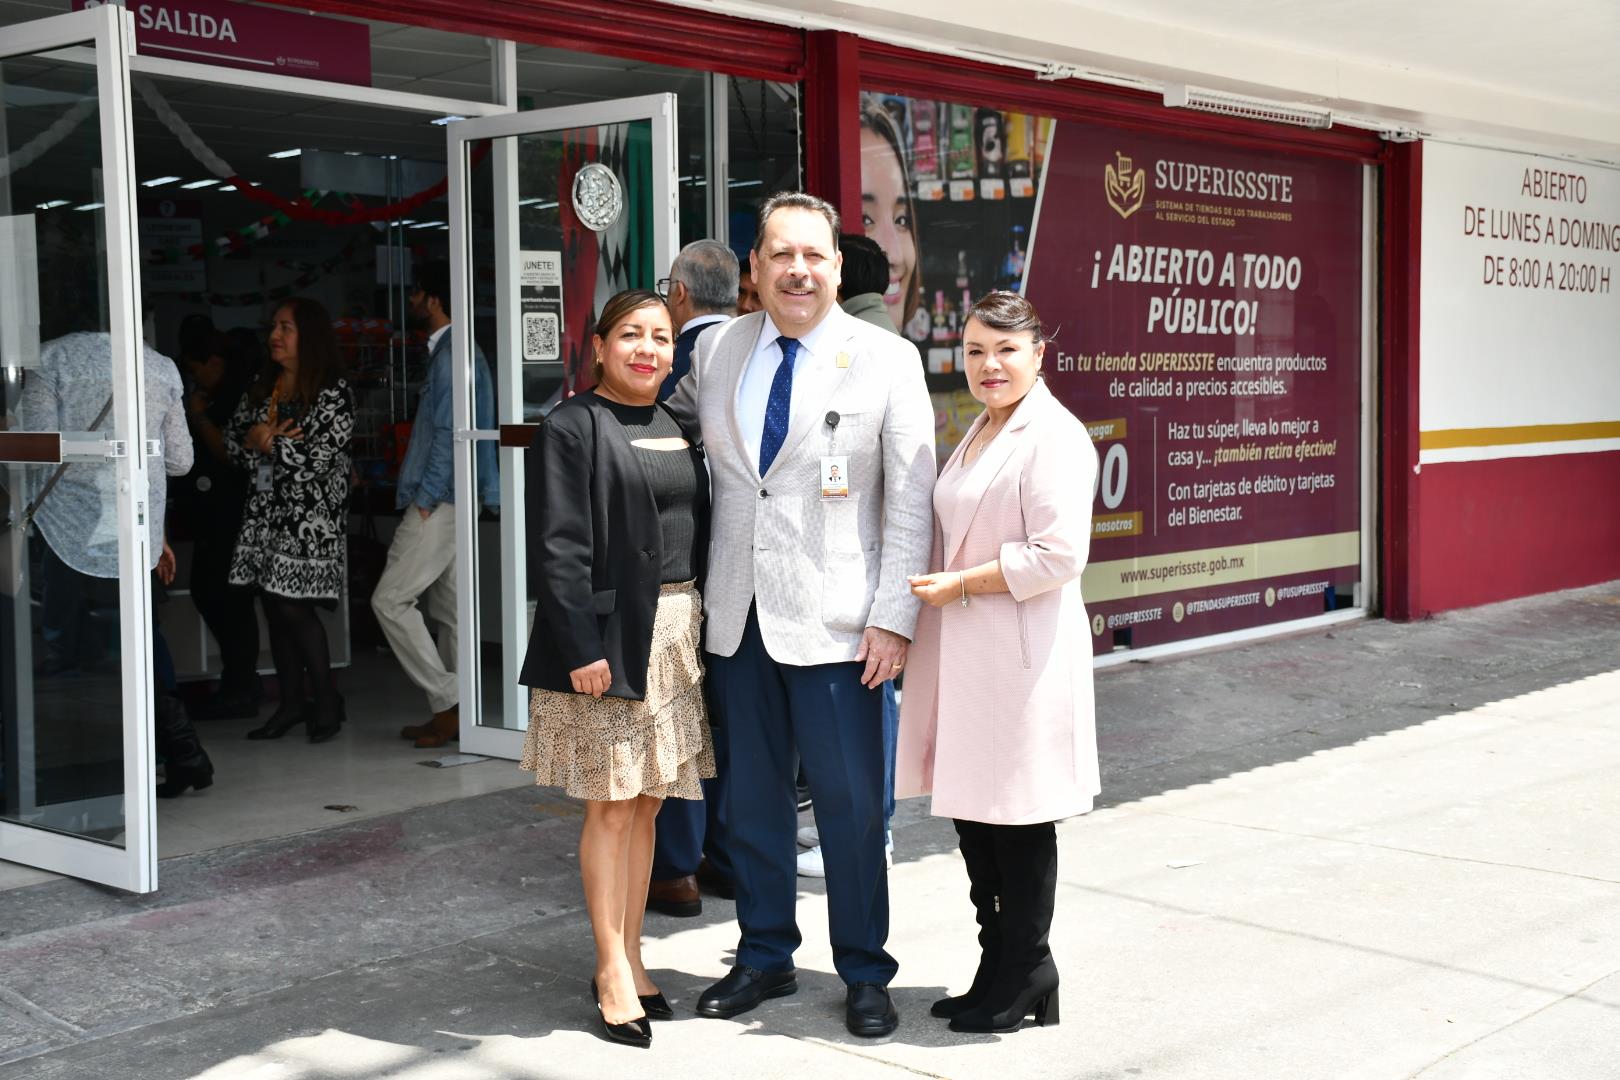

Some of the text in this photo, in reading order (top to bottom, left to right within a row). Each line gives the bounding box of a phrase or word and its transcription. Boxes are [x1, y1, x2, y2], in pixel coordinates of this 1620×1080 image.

[139, 4, 237, 43] SALIDA
[1155, 159, 1293, 203] SUPERISSSTE
[1521, 168, 1587, 204] ABIERTO
[1155, 200, 1293, 221] SISTEMA DE TIENDAS DE LOS TRABAJADORES
[1155, 212, 1236, 227] AL SERVICIO DEL ESTADO
[1464, 205, 1486, 238] DE
[1490, 208, 1541, 244] LUNES
[1544, 215, 1556, 245] A
[1218, 252, 1236, 287] A
[1243, 253, 1302, 291] TODO
[1483, 255, 1611, 294] DE 8:00 A 20:00 H
[1147, 287, 1259, 335] PÚBLICO!
[1057, 352, 1327, 376] En tu tienda SUPERISSSTE encuentra productos
[1109, 376, 1288, 401] de calidad a precios accesibles.
[1167, 417, 1320, 442] Haz tu súper, lleva lo mejor a
[1167, 450, 1194, 467] casa
[1213, 441, 1263, 468] ¡también
[1264, 441, 1293, 460] retira
[1294, 439, 1337, 463] efectivo!
[1093, 443, 1128, 509] 0
[1167, 472, 1335, 503] Con tarjetas de débito y tarjetas
[1095, 518, 1133, 533] nosotros
[1167, 505, 1243, 527] del Bienestar.
[1120, 556, 1244, 583] www.superissste.gob.mx
[1186, 592, 1260, 615] @TIENDASUPERISSSTE
[1107, 608, 1162, 628] @SUPERISSSTE
